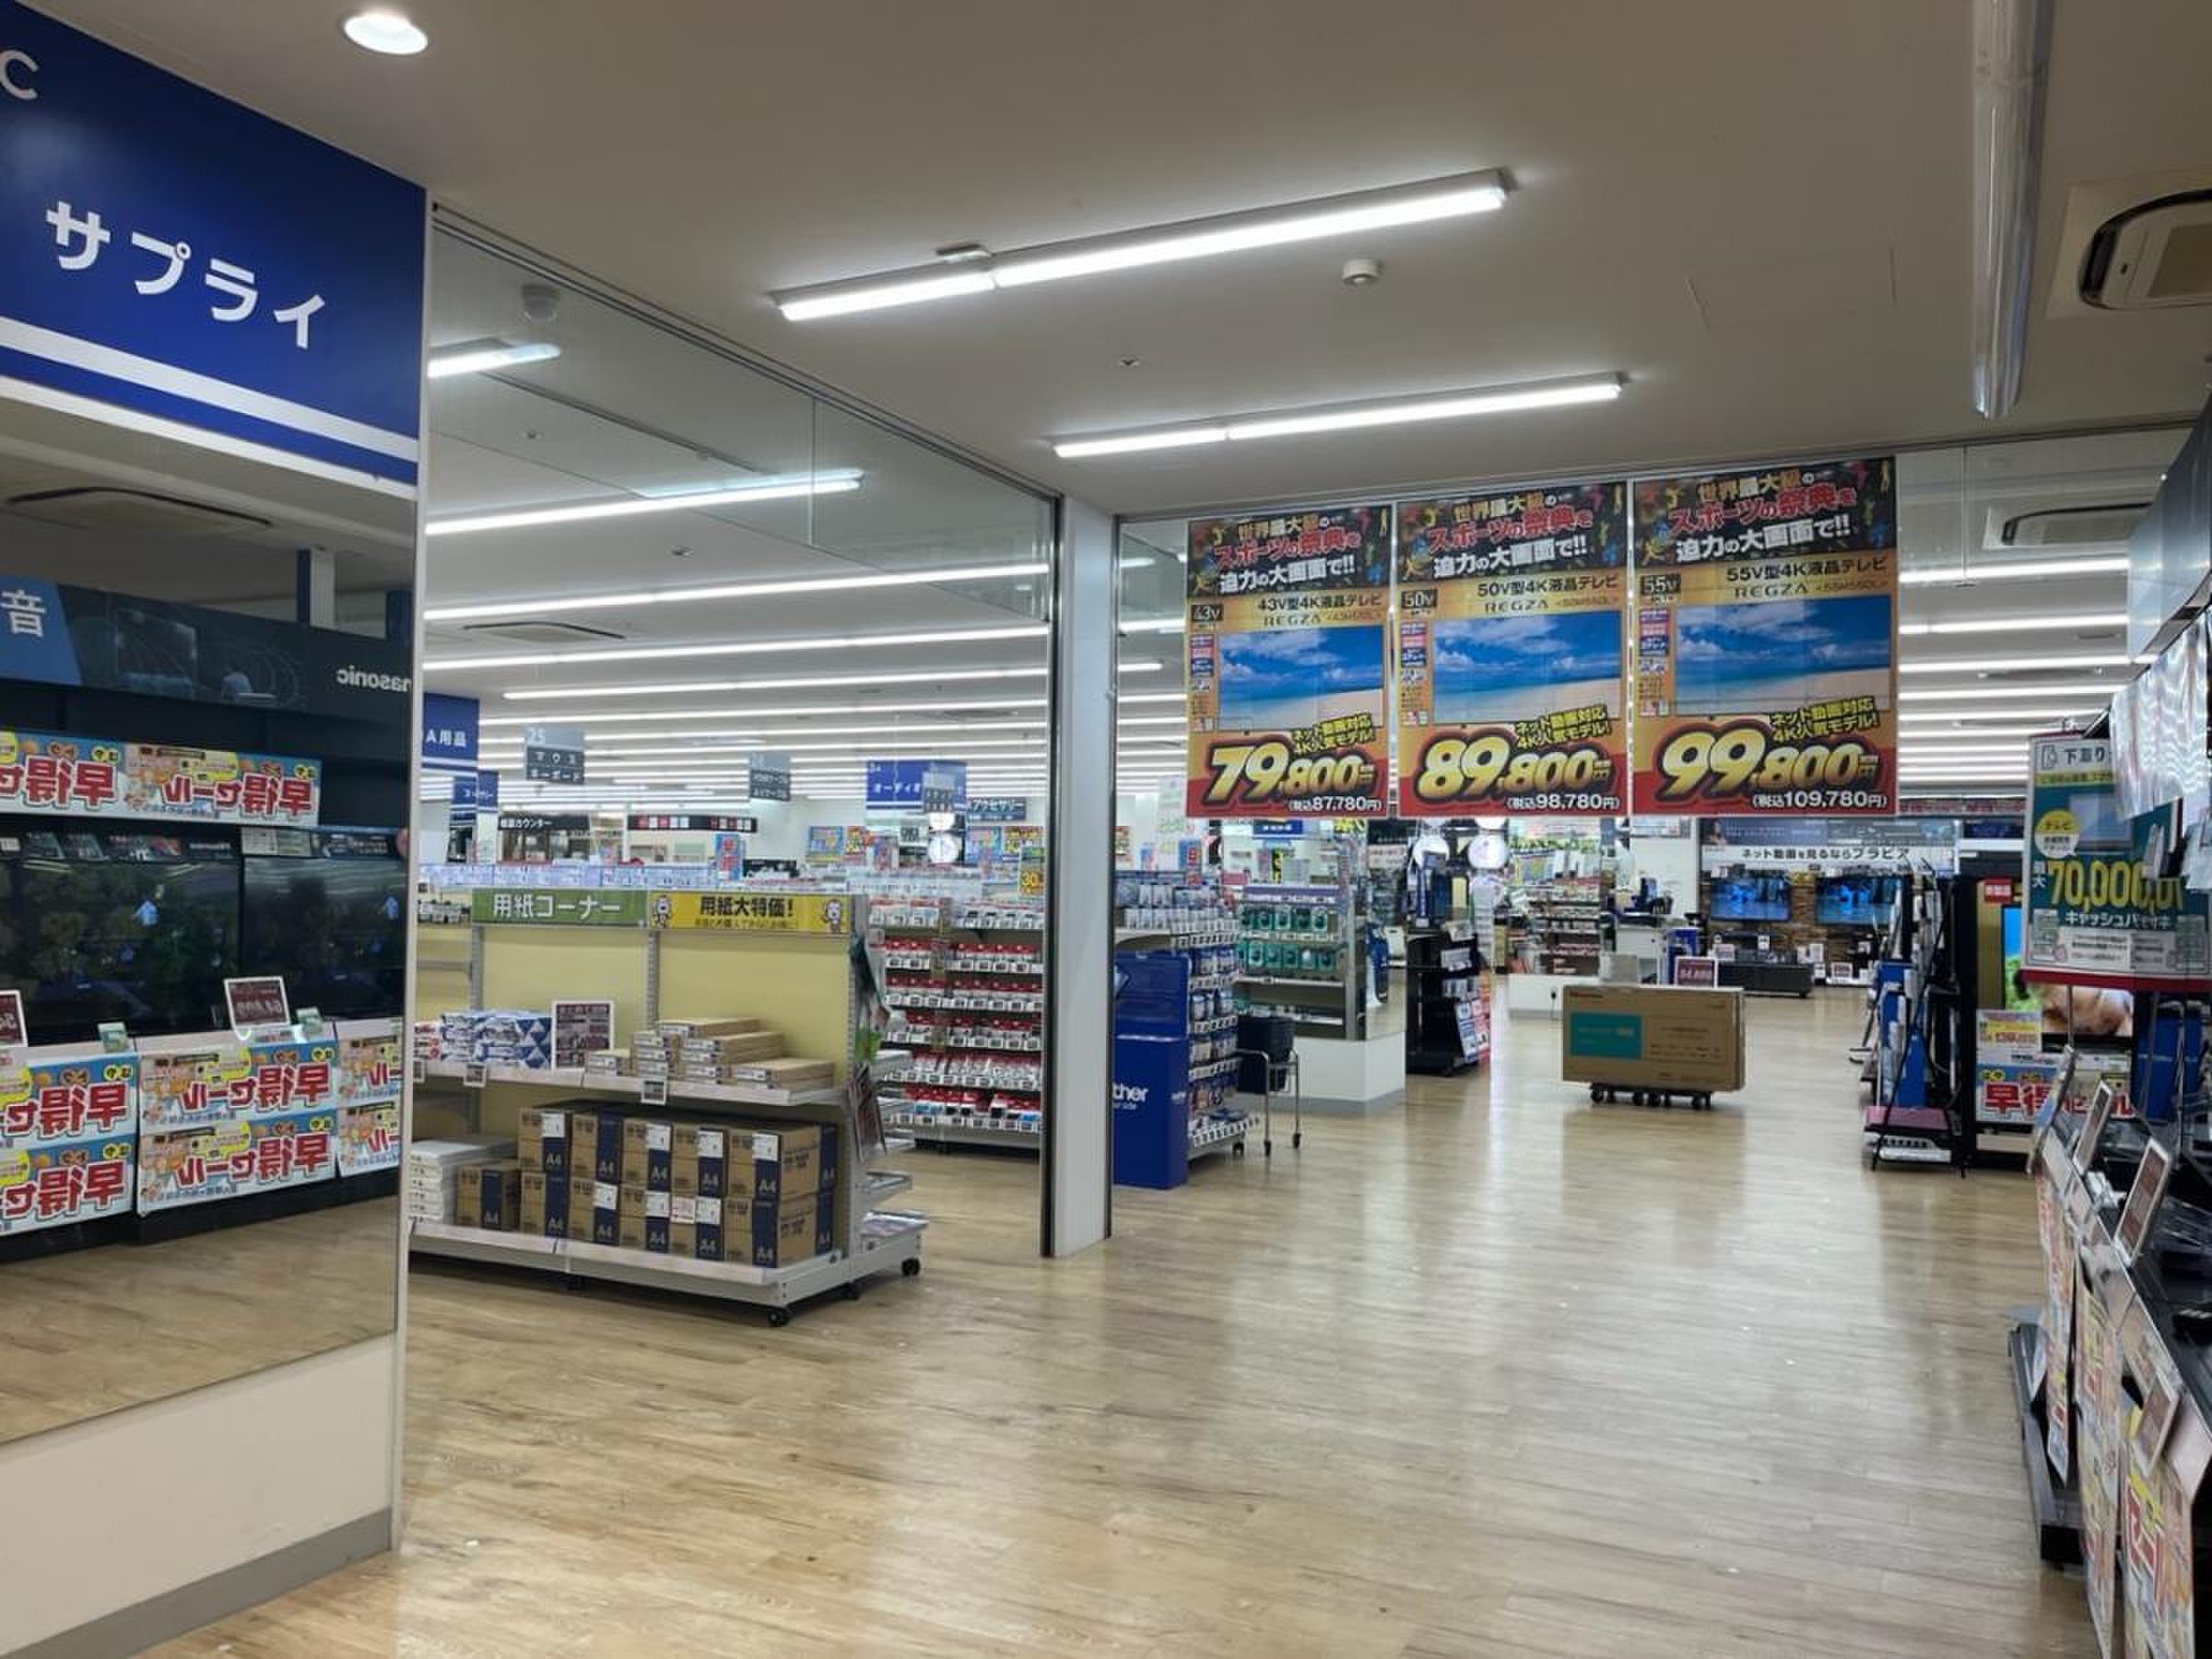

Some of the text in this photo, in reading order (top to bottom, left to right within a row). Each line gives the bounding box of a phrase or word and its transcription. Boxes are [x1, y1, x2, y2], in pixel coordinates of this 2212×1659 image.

[0, 50, 39, 100] C
[46, 200, 325, 350] サプライ
[494, 894, 621, 920] 用紙コーナー
[547, 1153, 561, 1166] A4
[652, 1164, 667, 1180] A4
